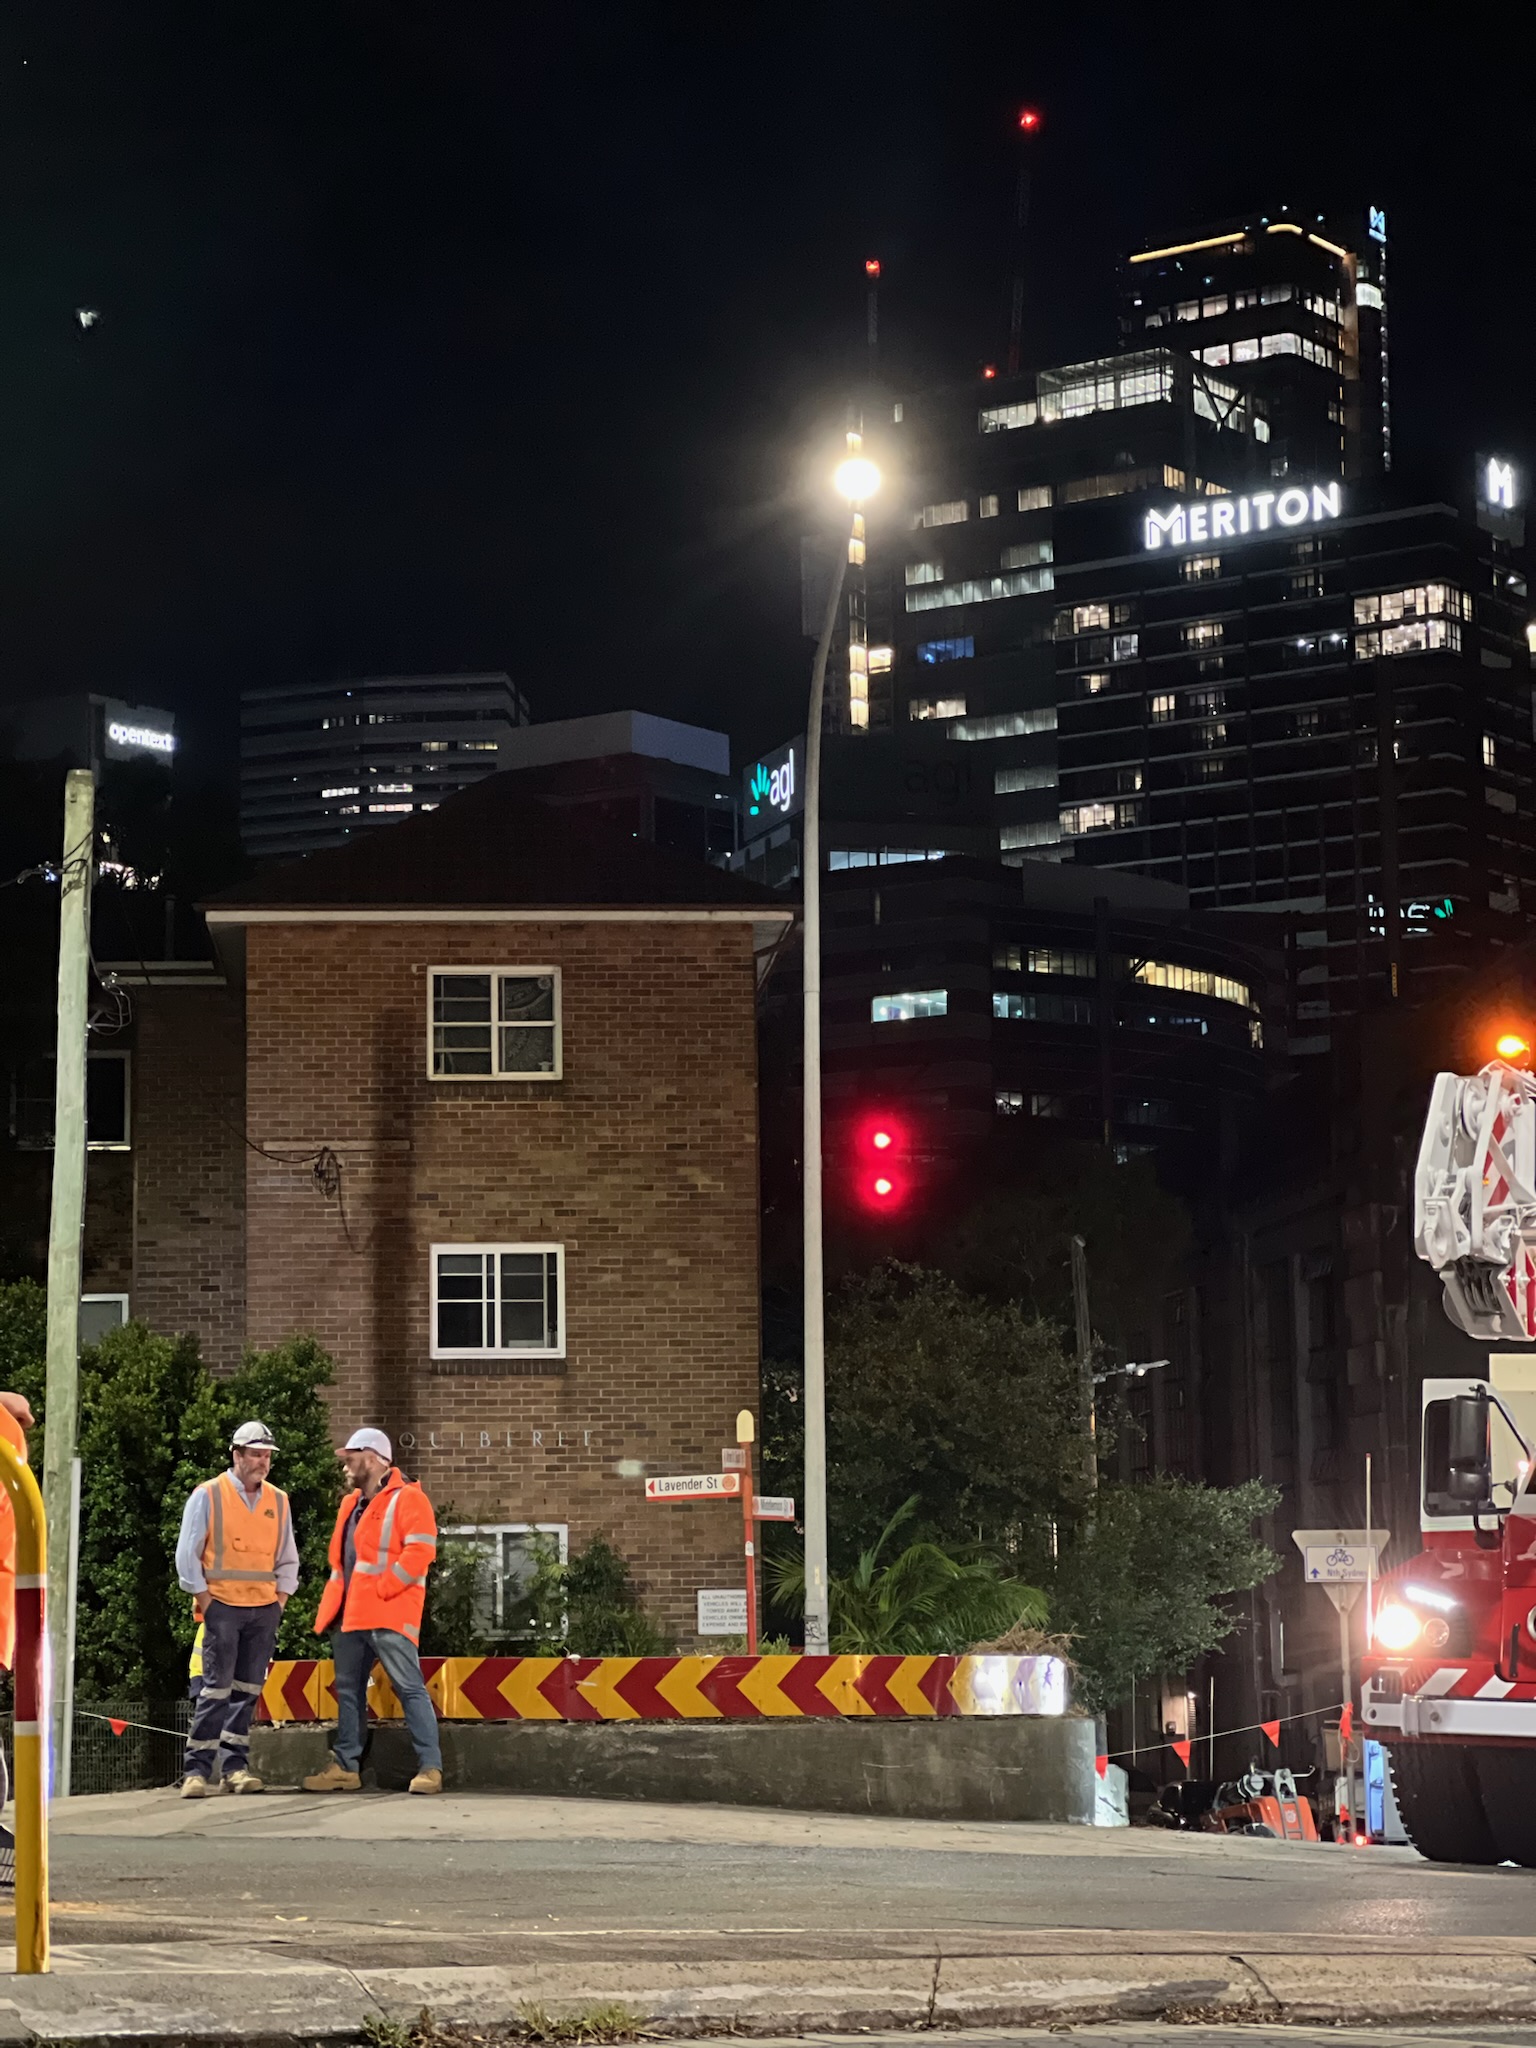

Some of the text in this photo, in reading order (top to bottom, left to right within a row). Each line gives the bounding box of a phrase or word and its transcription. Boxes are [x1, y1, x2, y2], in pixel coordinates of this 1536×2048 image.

[1145, 481, 1339, 549] MERITON
[109, 722, 174, 752] opentext
[770, 748, 795, 812] agl
[658, 1476, 718, 1492] Lavender St
